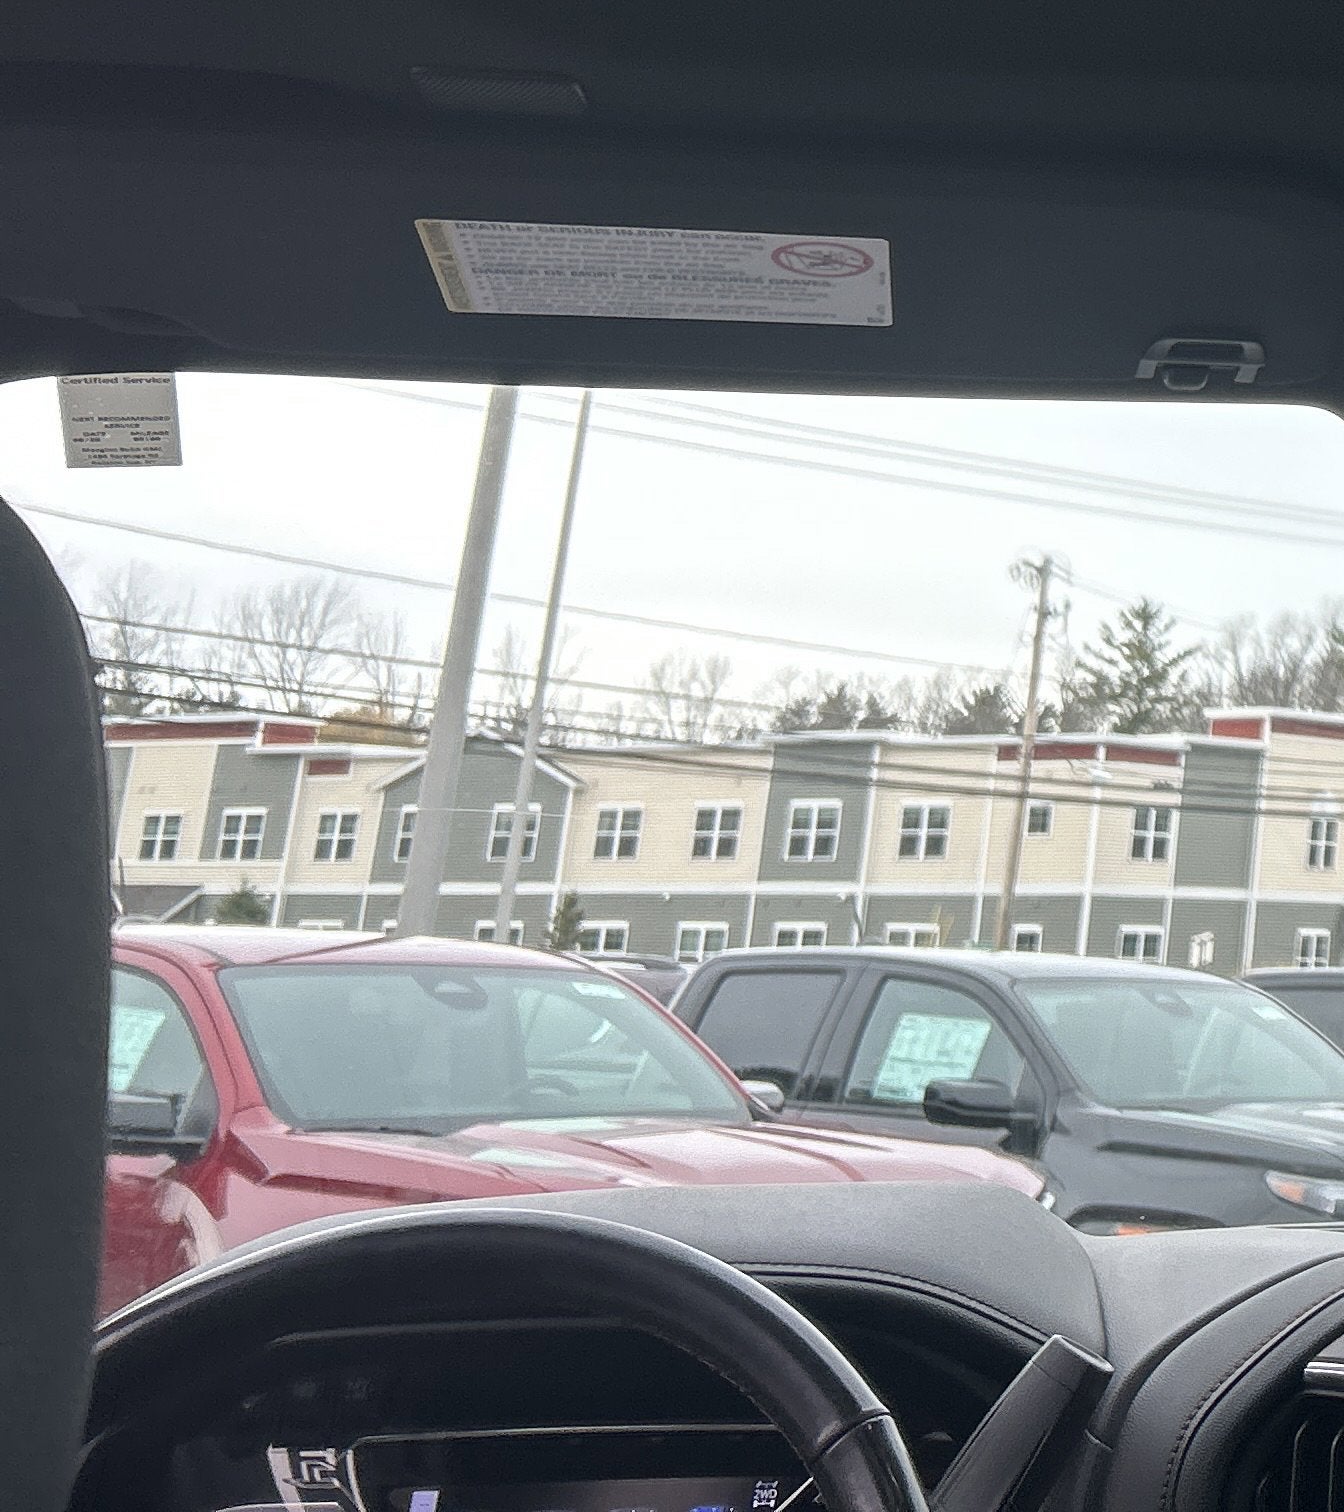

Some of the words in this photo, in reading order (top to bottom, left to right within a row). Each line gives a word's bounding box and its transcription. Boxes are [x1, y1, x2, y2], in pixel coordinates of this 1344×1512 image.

[455, 222, 512, 231] DEATH
[538, 226, 611, 236] SERIOUS
[61, 376, 119, 385] Certified
[122, 376, 171, 385] Service
[753, 1488, 779, 1499] 2WD
